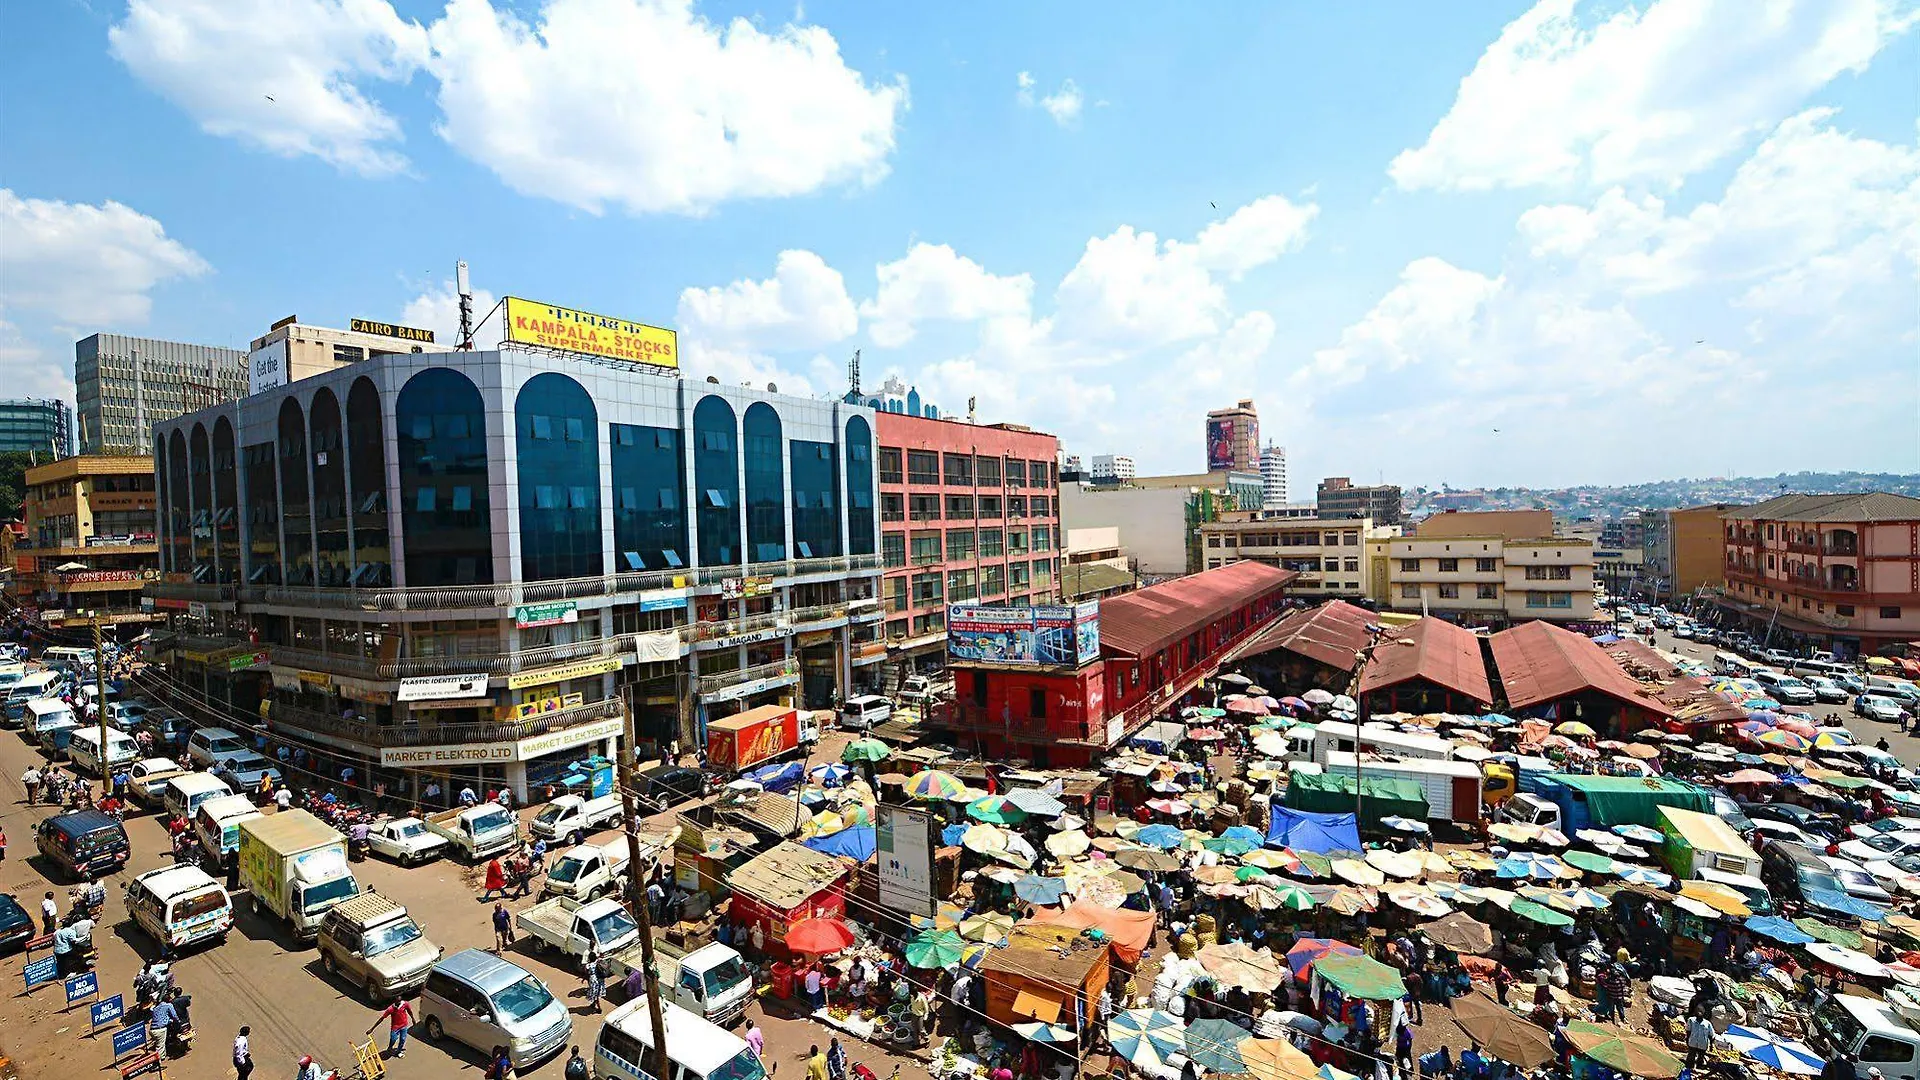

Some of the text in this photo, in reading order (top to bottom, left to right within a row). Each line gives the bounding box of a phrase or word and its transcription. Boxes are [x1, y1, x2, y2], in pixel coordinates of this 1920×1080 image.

[351, 319, 433, 342] CAIRO BANK
[516, 316, 598, 343] KAMPALA
[614, 334, 672, 356] STOCKS
[536, 333, 653, 361] SUPERMARKET
[256, 356, 278, 378] Get the
[513, 673, 549, 683] PLASTIC
[551, 665, 590, 677] IDENTITY
[592, 660, 618, 670] CARDS
[401, 674, 486, 686] PLASTIC IDENTITY CARDS
[522, 722, 621, 754] MARKET ELEKTRO LTD
[384, 747, 512, 762] MARKET ELEKTRO LTD
[69, 983, 96, 999] PARKING
[75, 980, 88, 990] NO
[94, 1006, 121, 1023] PARKING
[101, 1002, 114, 1012] NO
[116, 1033, 143, 1048] PARKING
[125, 1032, 135, 1040] NO
